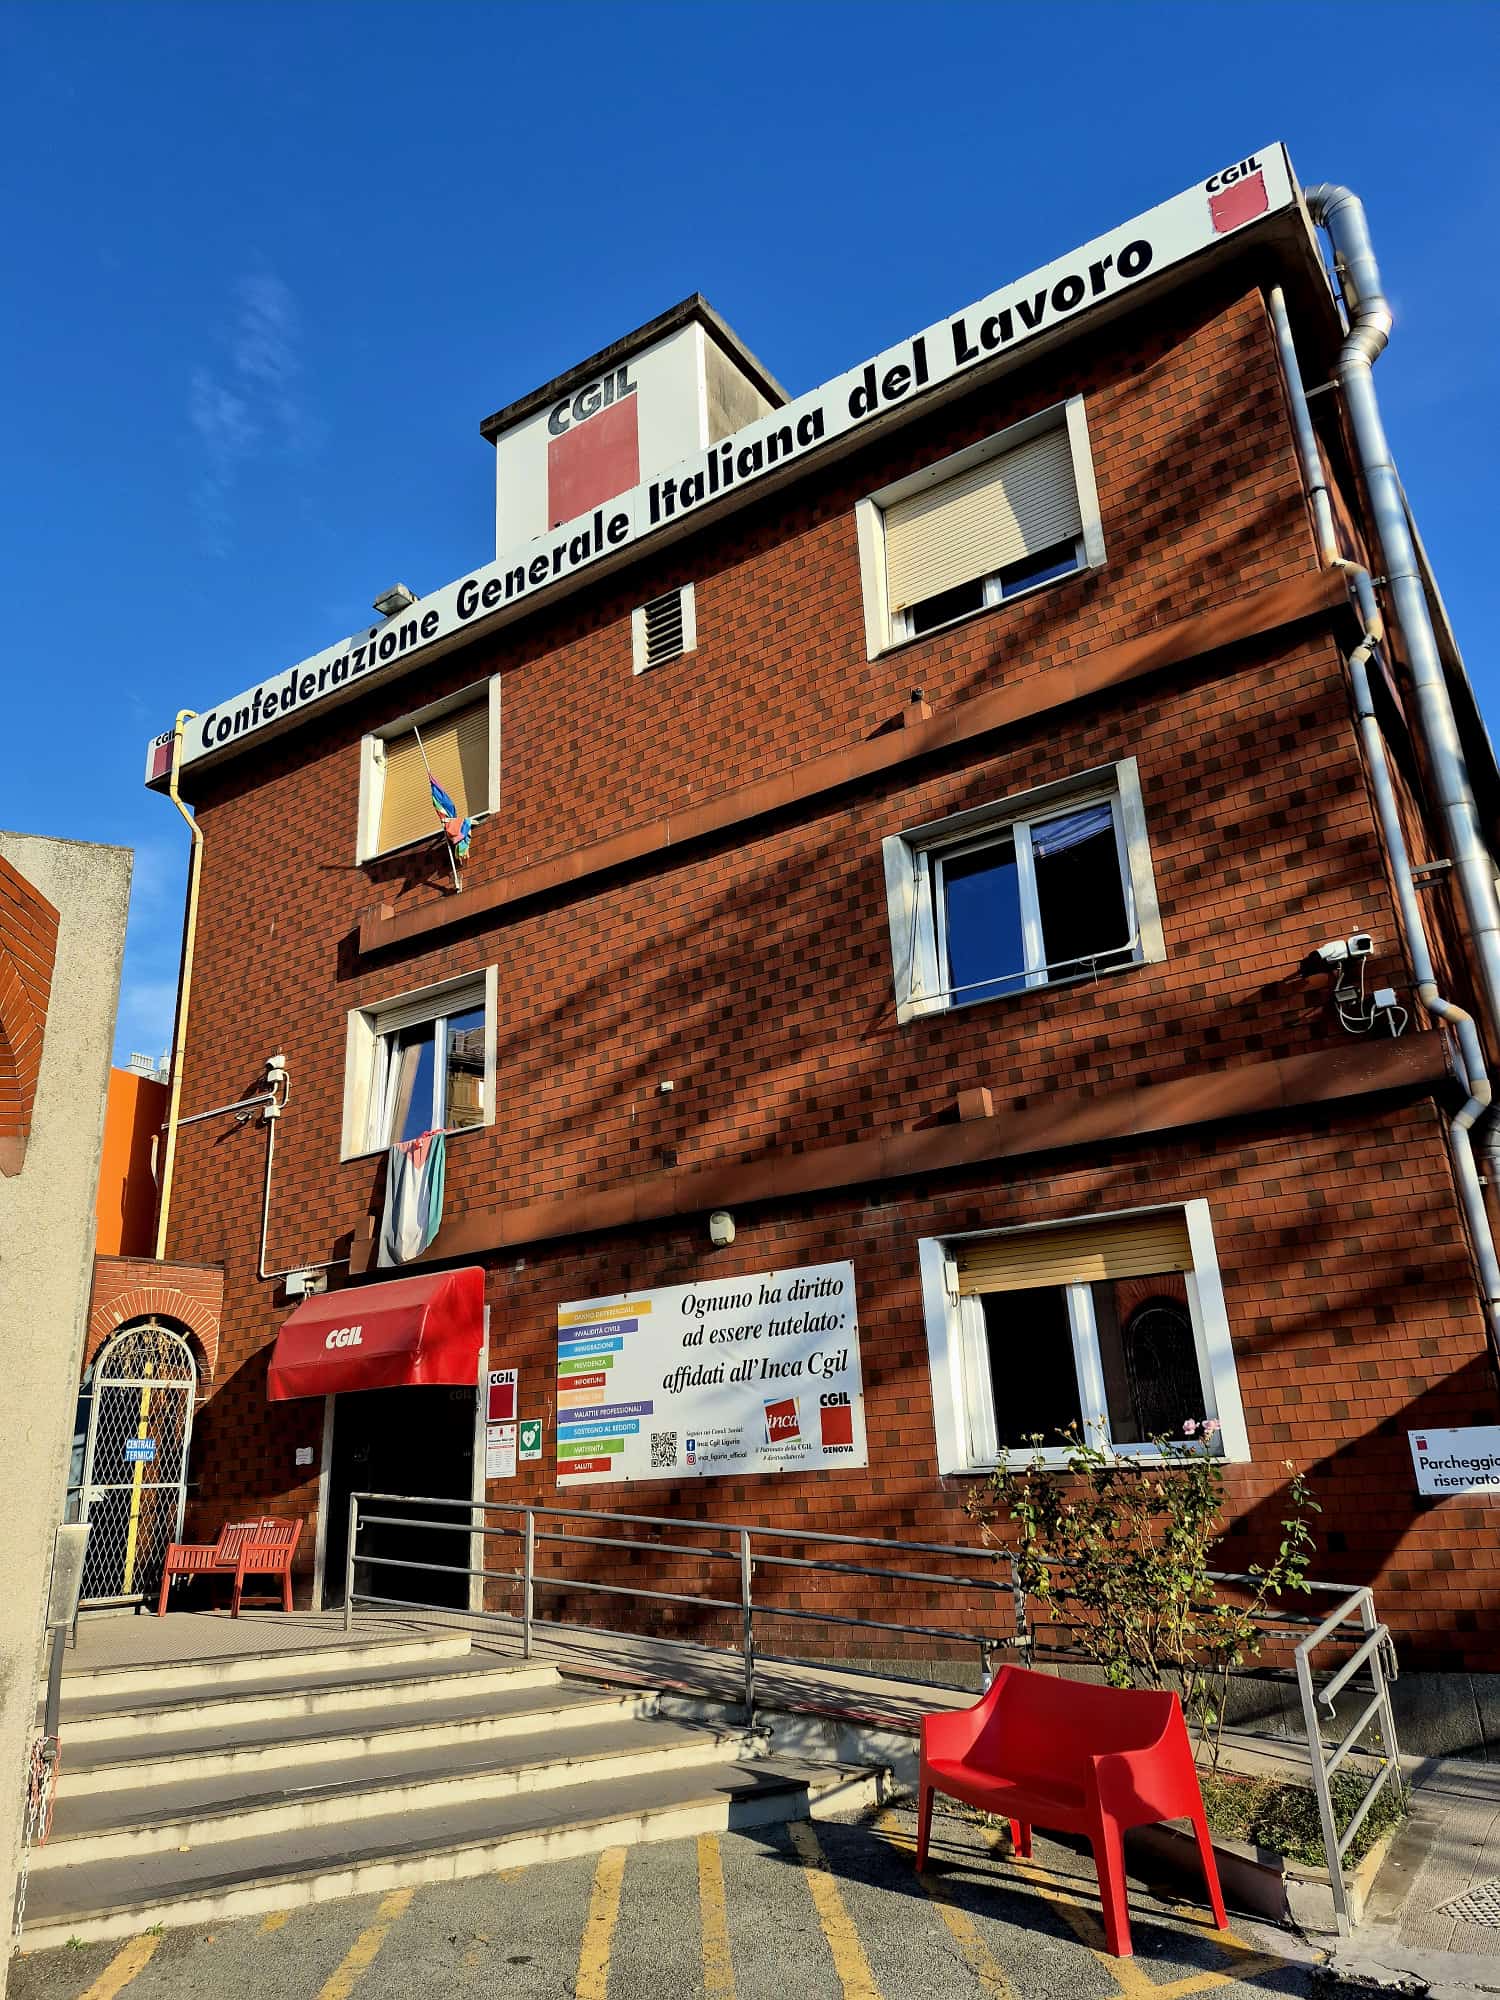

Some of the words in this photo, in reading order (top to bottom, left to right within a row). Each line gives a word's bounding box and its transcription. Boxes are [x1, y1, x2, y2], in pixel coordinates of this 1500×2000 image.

[1205, 157, 1262, 193] CGIL
[547, 365, 637, 436] CGIL
[201, 609, 440, 749] Confederazione
[456, 510, 630, 620] Generale
[648, 406, 825, 525] Italiana
[848, 337, 930, 420] del
[951, 239, 1154, 367] Lavoro
[681, 1292, 753, 1318] Ognuno
[758, 1284, 782, 1305] ha
[787, 1277, 844, 1301] diritto
[325, 1325, 363, 1350] CGIL
[682, 1325, 705, 1347] ad
[709, 1323, 763, 1344] essere
[768, 1311, 846, 1337] tutelato:
[490, 1372, 515, 1384] CGIL
[662, 1362, 725, 1393] affidati
[807, 1349, 849, 1379] Cgil
[820, 1392, 851, 1407] CGIL
[767, 1414, 797, 1429] inca
[126, 1440, 155, 1449] CENTRALE
[822, 1446, 854, 1454] GENOVA
[126, 1450, 154, 1460] TERMICA
[1433, 1474, 1499, 1487] riservato
